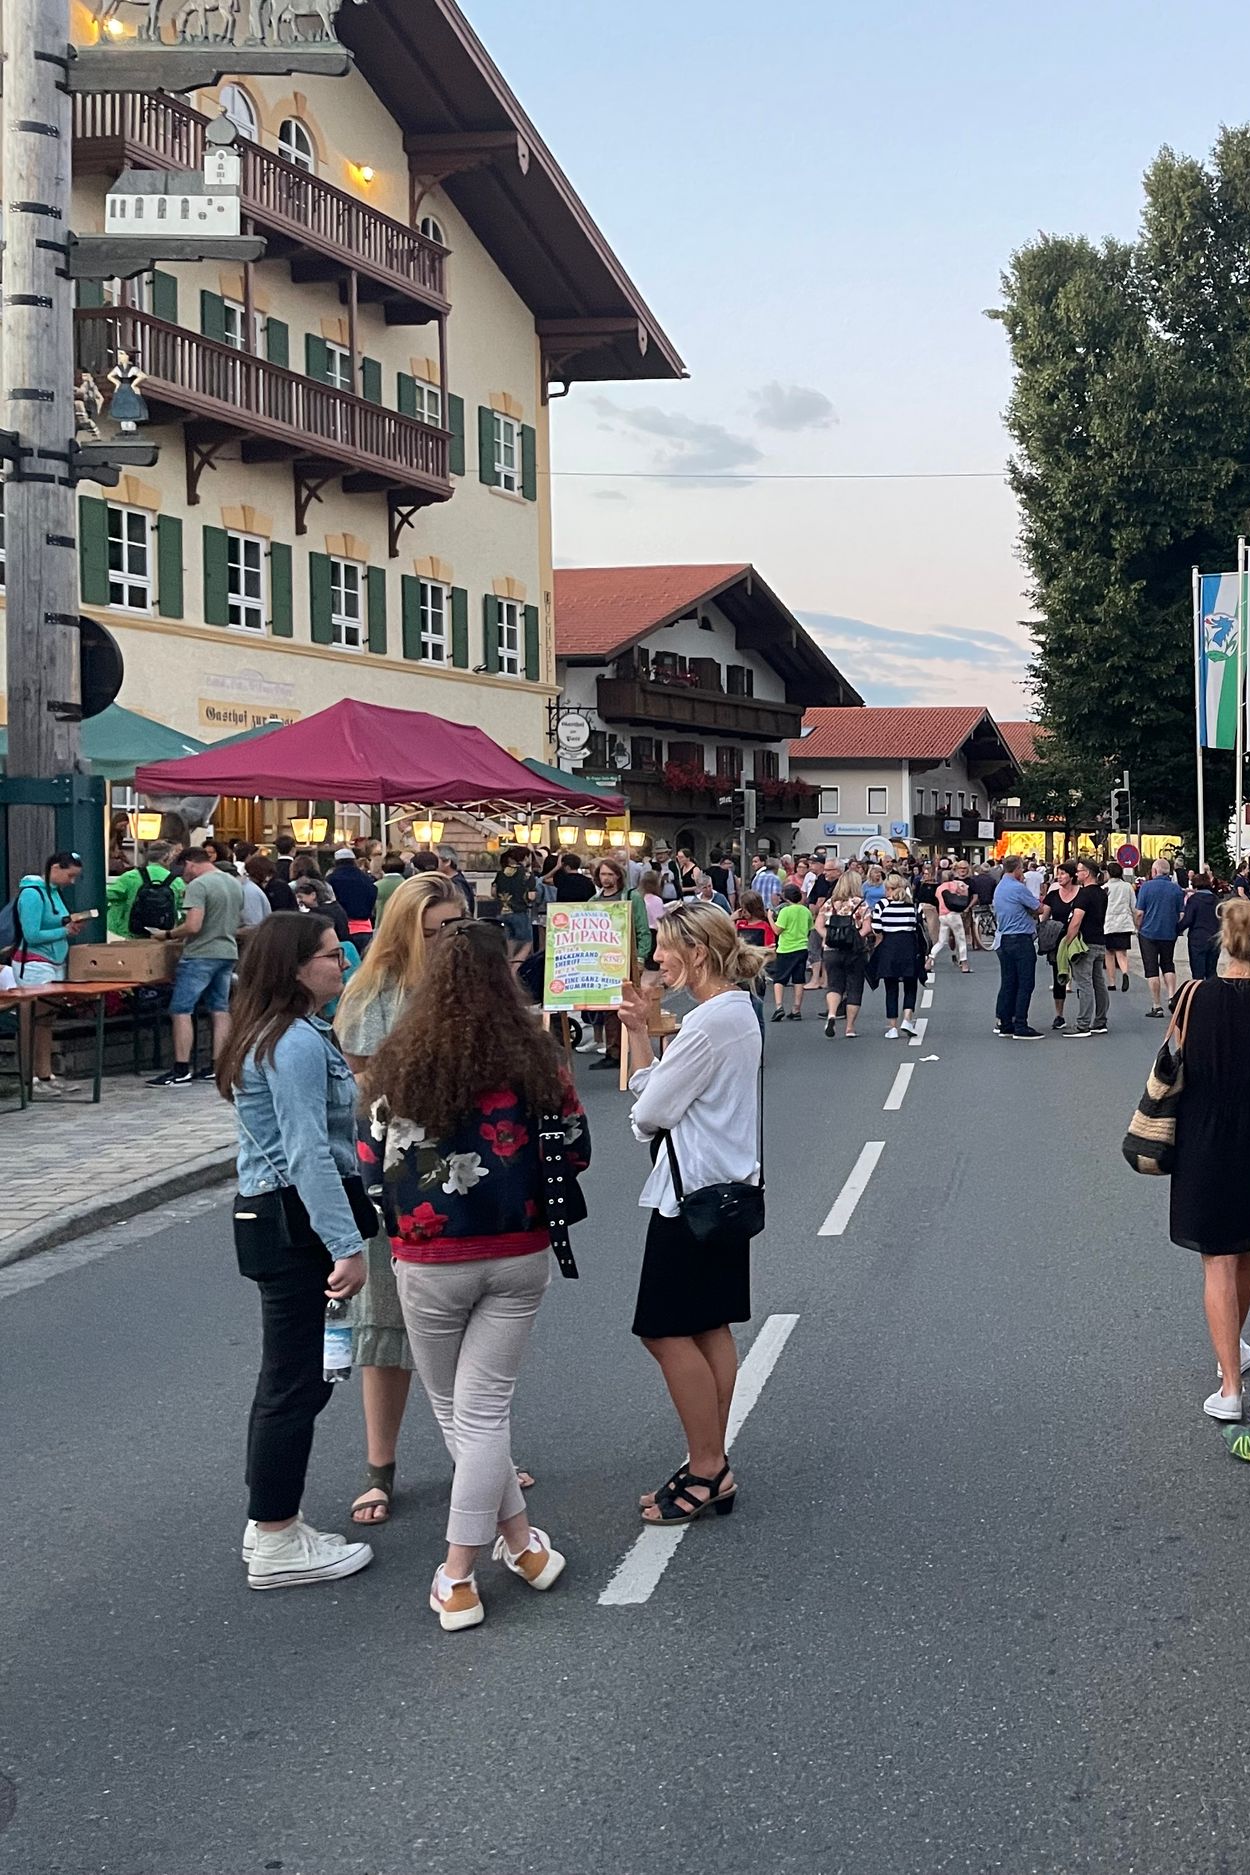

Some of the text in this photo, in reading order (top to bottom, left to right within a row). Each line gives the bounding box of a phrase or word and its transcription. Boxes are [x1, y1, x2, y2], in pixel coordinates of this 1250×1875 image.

[205, 706, 248, 727] Gasthof
[572, 918, 610, 930] KINO
[556, 930, 619, 946] IM PARK
